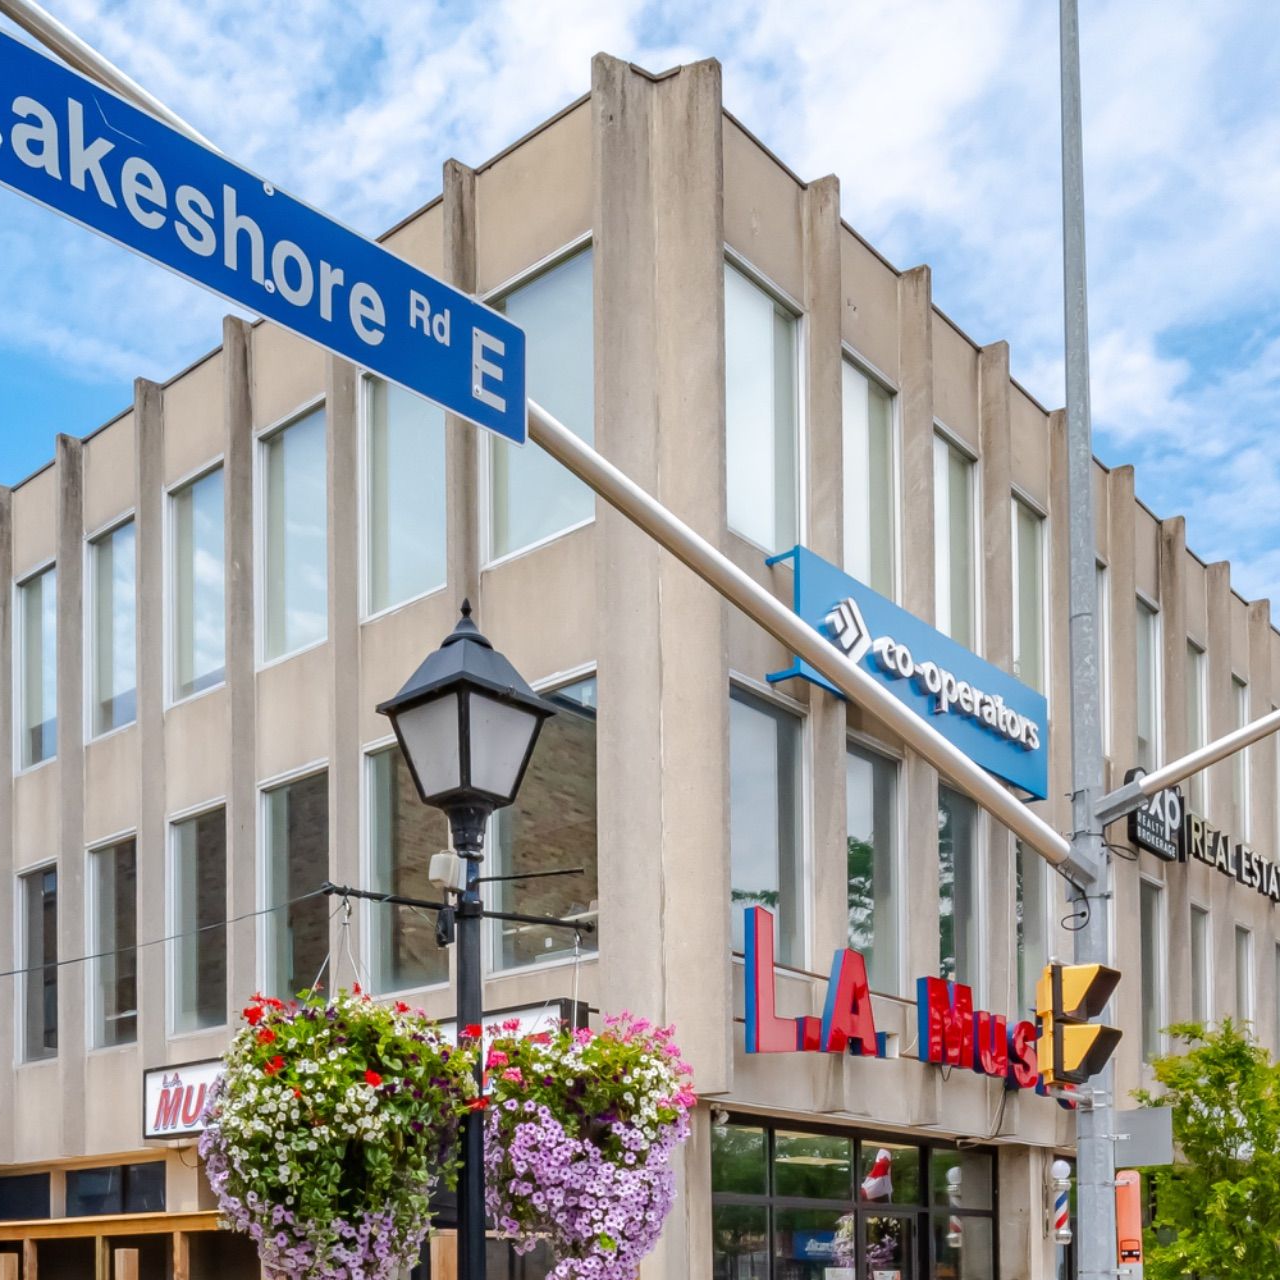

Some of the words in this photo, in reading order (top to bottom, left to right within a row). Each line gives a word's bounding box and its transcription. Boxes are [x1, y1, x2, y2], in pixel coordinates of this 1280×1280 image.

[409, 288, 451, 348] Rd
[470, 326, 507, 413] E
[873, 636, 1041, 750] co-operators
[1137, 811, 1165, 836] REALTY
[1137, 825, 1177, 859] BROKERAGE
[1190, 815, 1237, 877] REAL
[154, 1082, 208, 1130] MU
